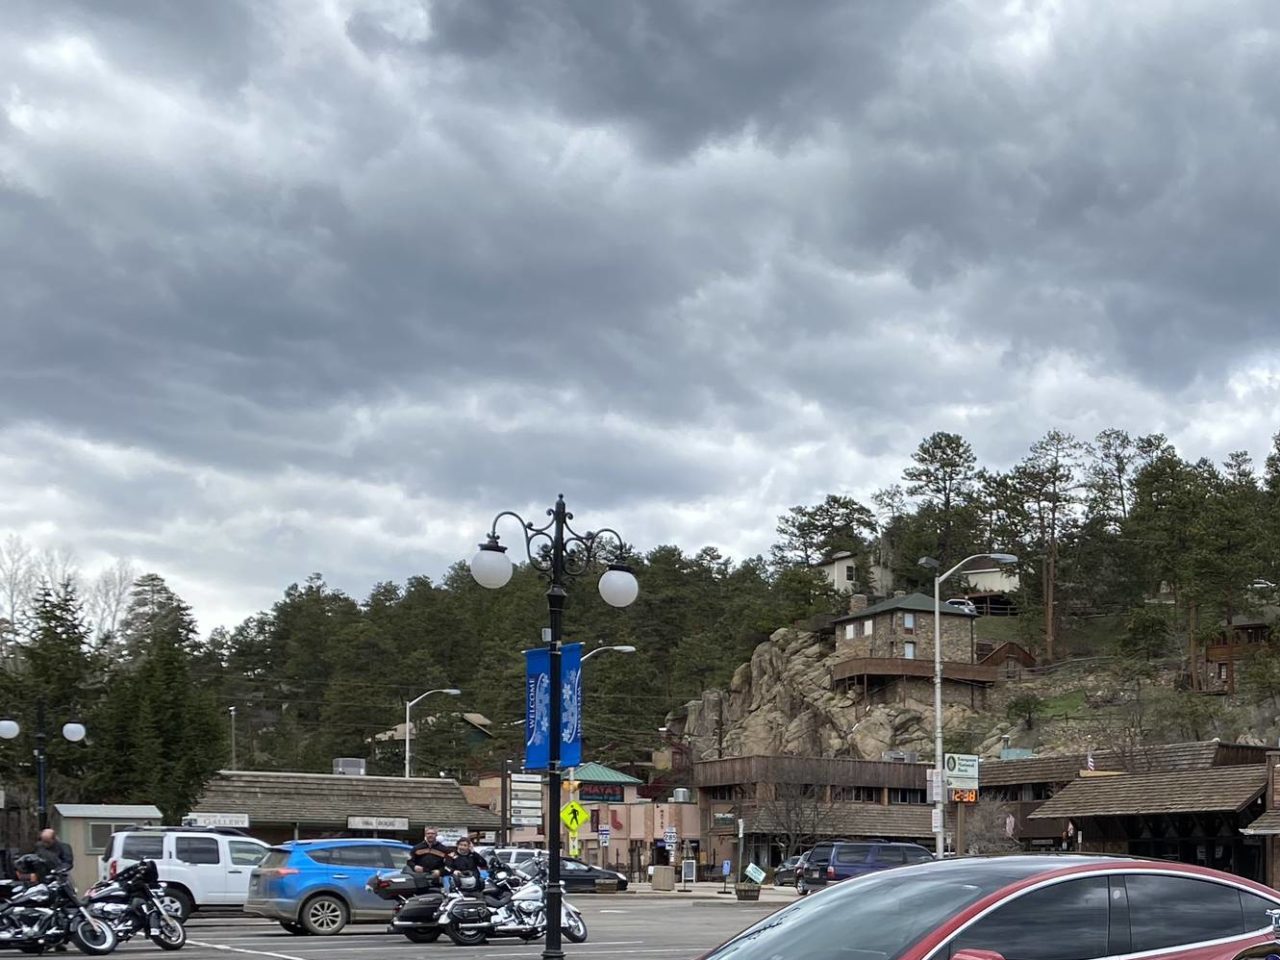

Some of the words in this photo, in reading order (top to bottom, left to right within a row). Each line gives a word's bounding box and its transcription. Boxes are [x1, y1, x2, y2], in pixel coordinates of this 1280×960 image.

[952, 789, 976, 802] 12:38
[203, 818, 246, 826] GALLERY
[664, 833, 677, 841] 285
